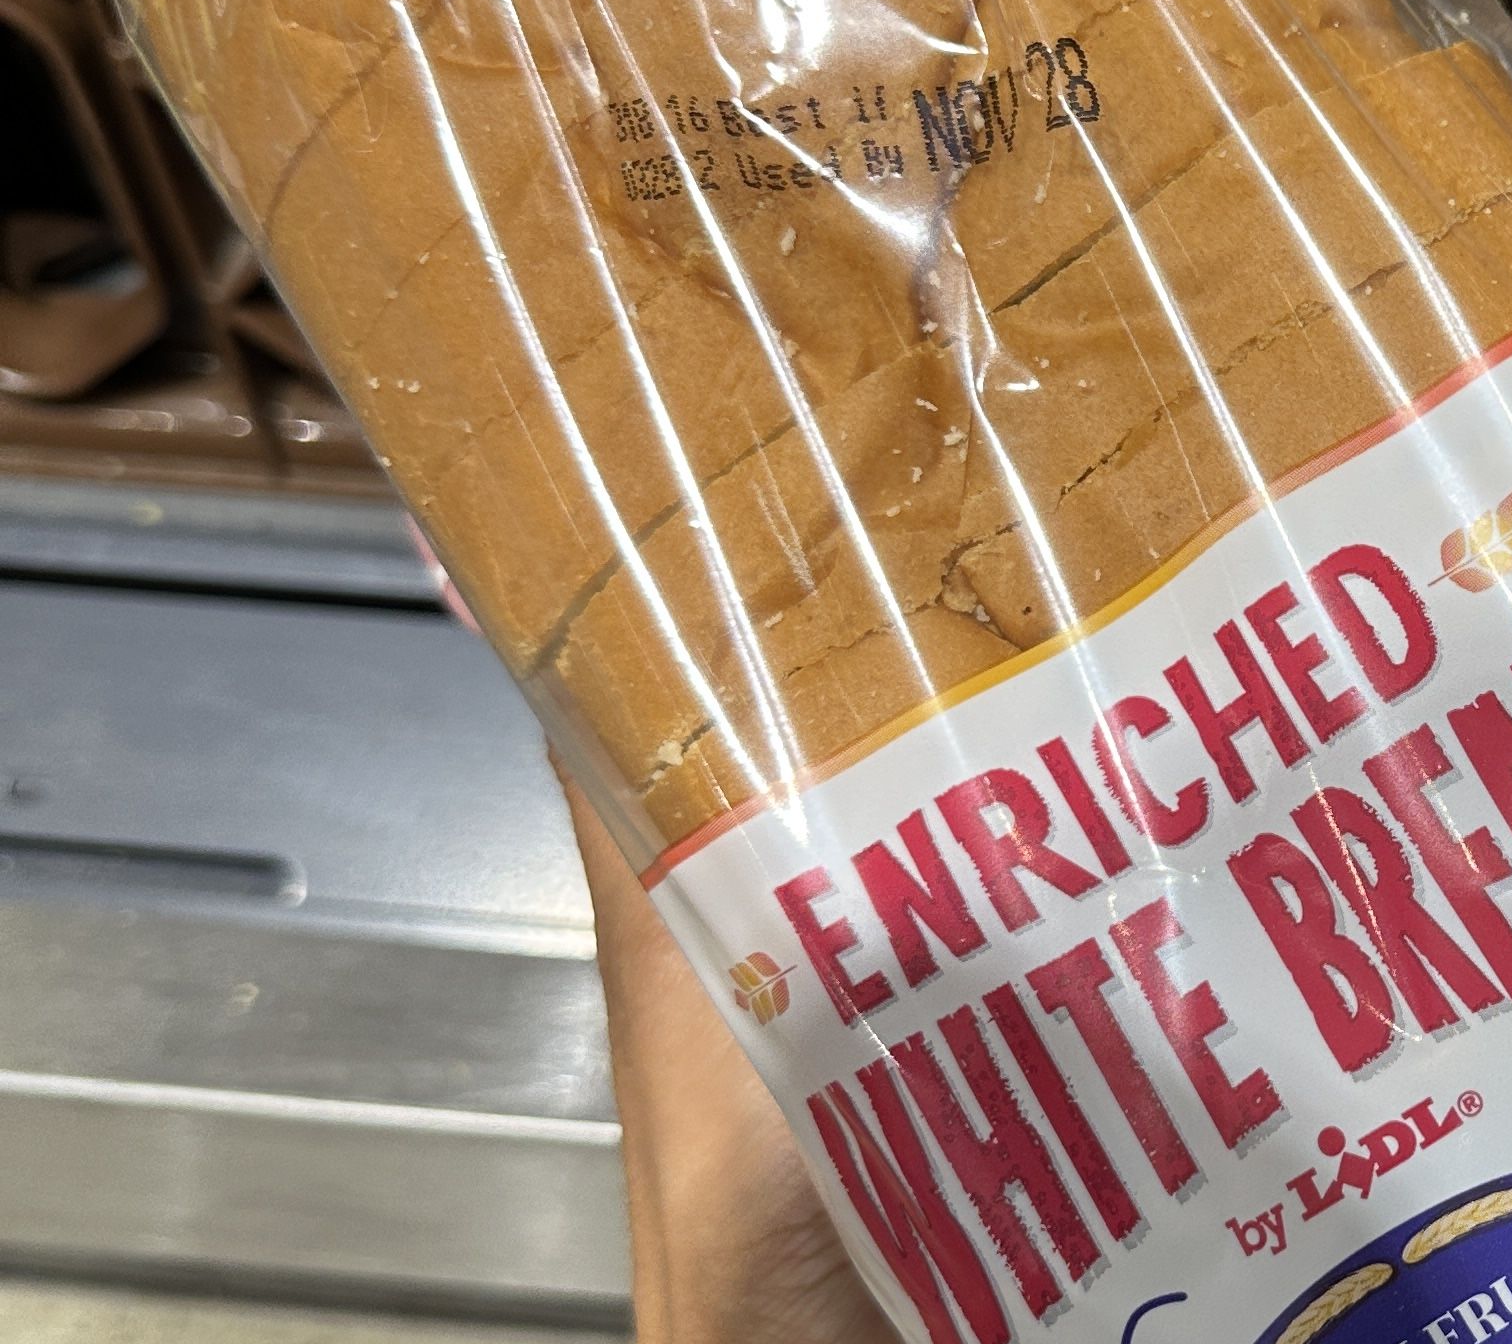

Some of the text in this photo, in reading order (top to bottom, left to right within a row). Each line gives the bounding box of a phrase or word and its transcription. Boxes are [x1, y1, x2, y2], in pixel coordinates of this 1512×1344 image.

[913, 38, 1100, 171] NOV 28
[773, 543, 1441, 1026] ENRICHED
[1225, 1203, 1287, 1256] by
